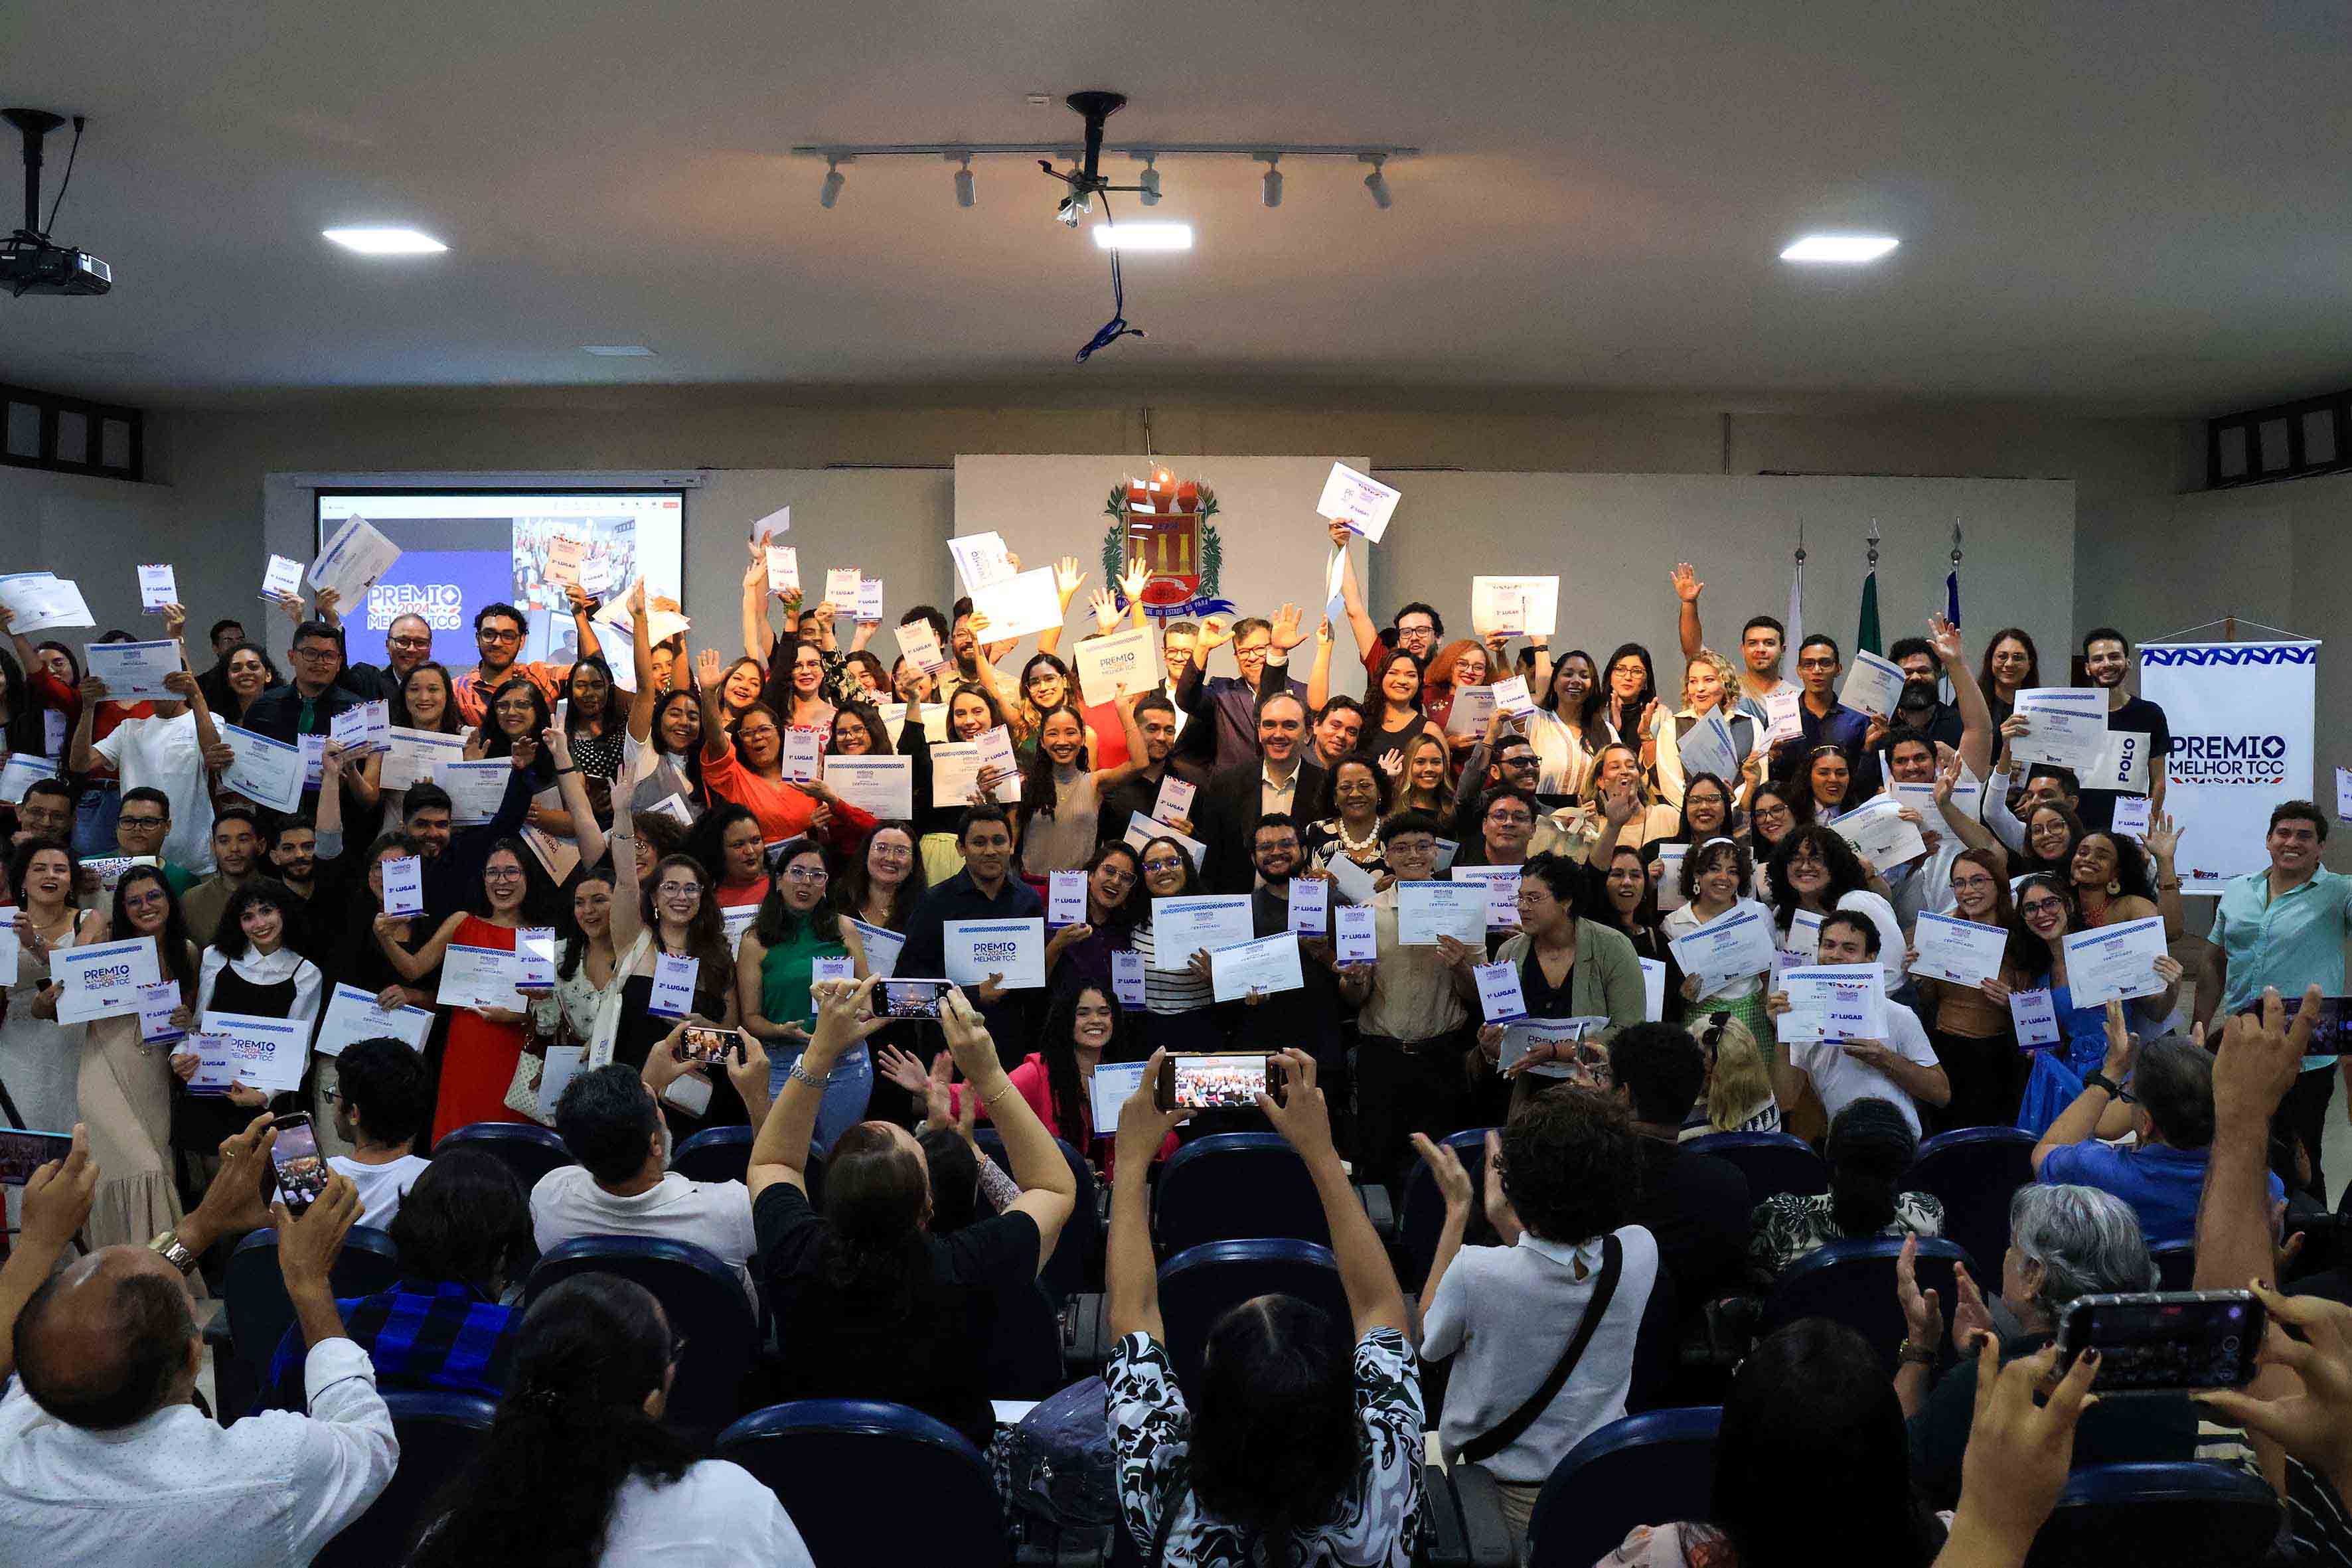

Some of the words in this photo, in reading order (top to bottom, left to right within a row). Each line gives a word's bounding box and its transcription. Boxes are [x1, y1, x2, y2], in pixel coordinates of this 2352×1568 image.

[398, 603, 430, 615] 2024
[1165, 607, 1184, 616] ESTADO
[431, 616, 459, 627] TCC
[913, 643, 932, 653] LUGAR
[1099, 652, 1135, 667] PREMIO
[2169, 736, 2286, 759] PREMIO
[990, 750, 1008, 760] LUGAR
[2169, 761, 2242, 775] MELHOR
[2246, 761, 2284, 775] TCC
[1167, 801, 1184, 812] LUGAR
[973, 942, 1016, 953] PREMIO
[84, 965, 129, 980] PREMIO
[85, 980, 115, 990] MELHOR
[666, 984, 690, 992] LUGAR
[1494, 988, 1517, 998] LUGAR
